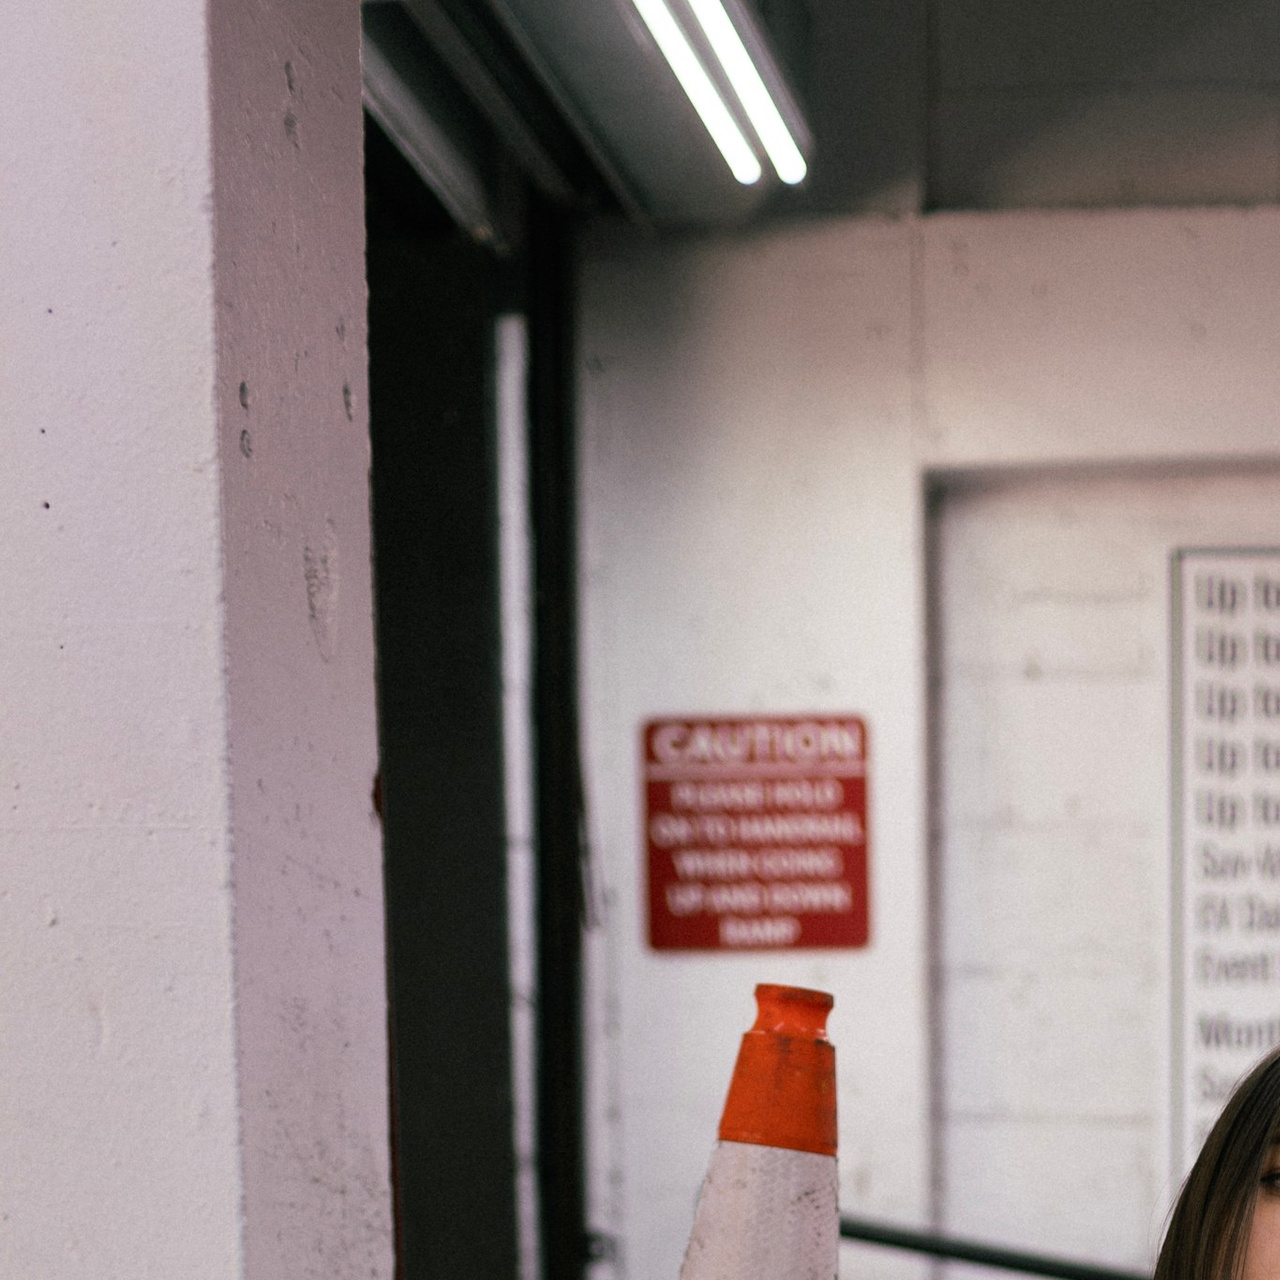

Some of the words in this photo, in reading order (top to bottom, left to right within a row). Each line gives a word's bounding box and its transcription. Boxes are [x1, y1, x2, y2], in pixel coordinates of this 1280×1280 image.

[1198, 573, 1243, 623] Up
[1198, 629, 1243, 678] Up
[1198, 683, 1243, 731] Up
[652, 724, 863, 763] CAUTION
[1198, 736, 1243, 785] Up
[770, 780, 844, 810] HOLD
[1198, 791, 1243, 838] Up
[699, 813, 732, 847] TO
[707, 883, 762, 915] AND
[770, 883, 851, 915] DOWN
[1198, 949, 1274, 987] Event
